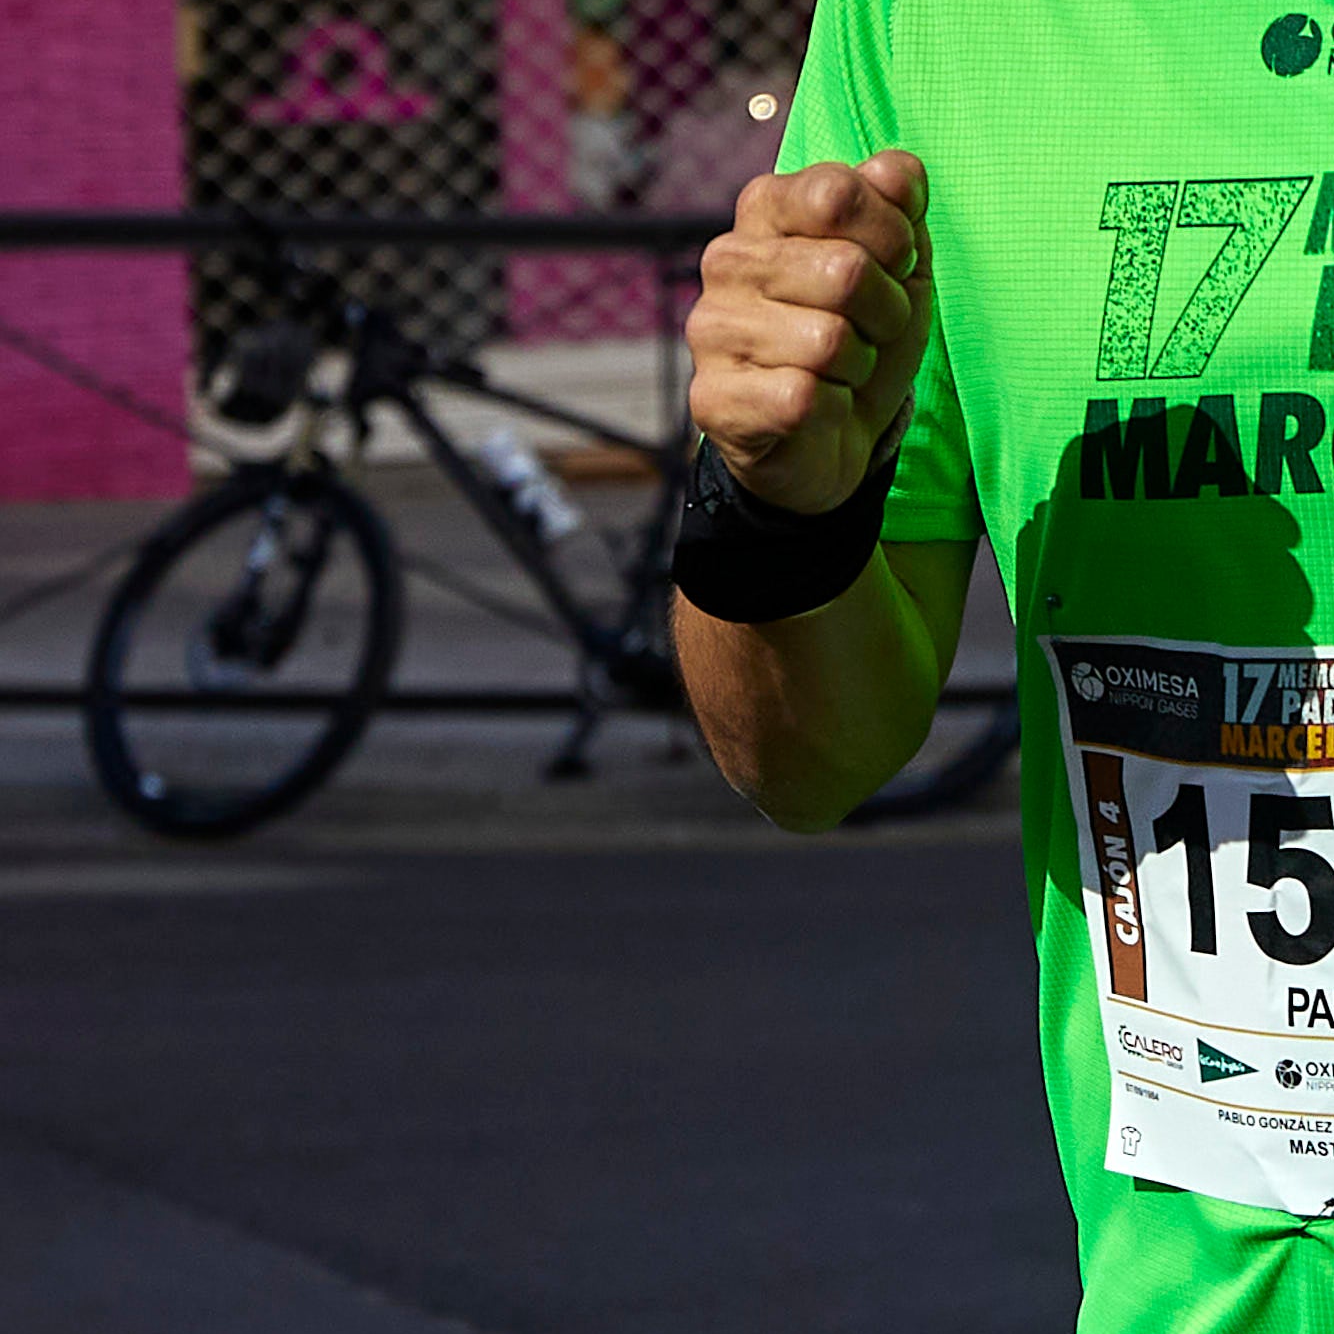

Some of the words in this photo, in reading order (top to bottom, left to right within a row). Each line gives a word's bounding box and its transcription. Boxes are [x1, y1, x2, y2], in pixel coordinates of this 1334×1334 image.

[1096, 175, 1314, 382] 17
[1105, 666, 1200, 699] OXIMESA
[1222, 662, 1277, 724] 17
[1109, 690, 1154, 711] NIPPON
[1157, 698, 1199, 720] GASES
[1097, 800, 1121, 824] 4
[1103, 835, 1140, 946] CAJÓN
[1123, 1031, 1184, 1062] CALERO
[1218, 1109, 1256, 1127] PABLO
[1258, 1115, 1333, 1134] GONZÁLEZ
